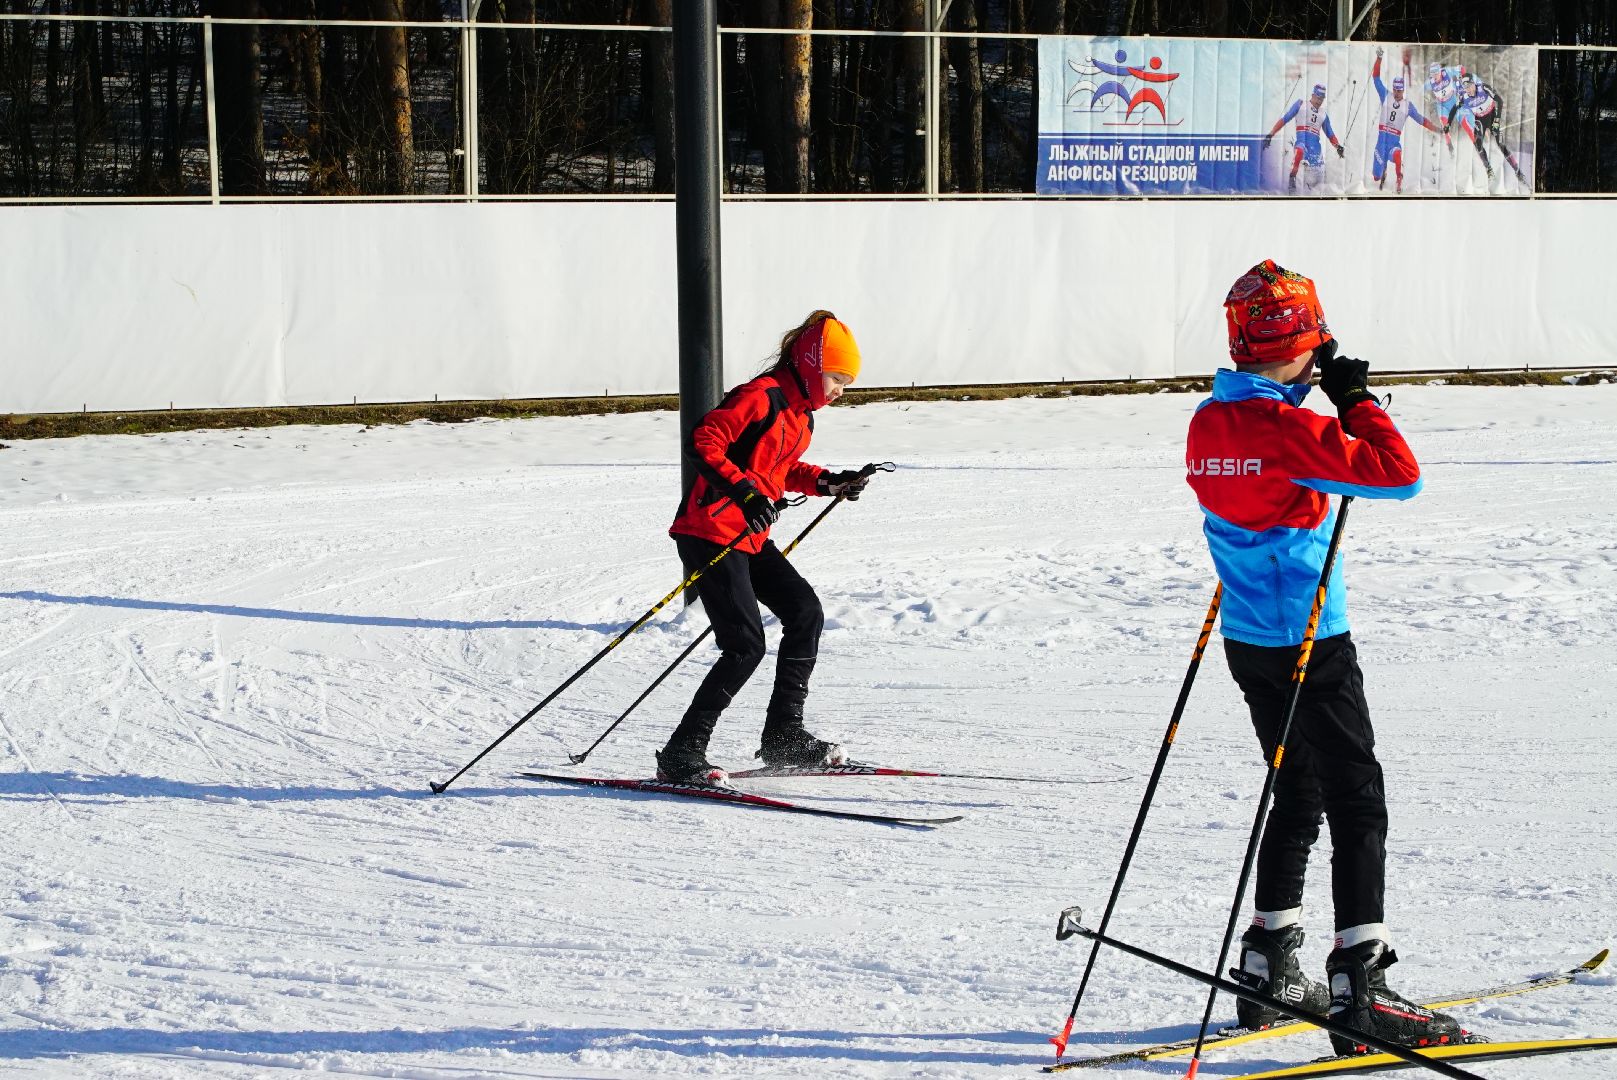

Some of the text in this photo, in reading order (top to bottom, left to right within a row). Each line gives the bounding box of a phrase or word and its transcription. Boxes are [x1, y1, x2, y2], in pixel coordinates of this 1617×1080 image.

[1389, 111, 1397, 122] 8
[1048, 141, 1249, 164] ЛЫЖНЫЙ СТАДИОН ИМЕНИ
[1047, 162, 1198, 184] АНФИСЫ РЕЗЦОВОЙ
[1374, 994, 1435, 1018] SPINE
